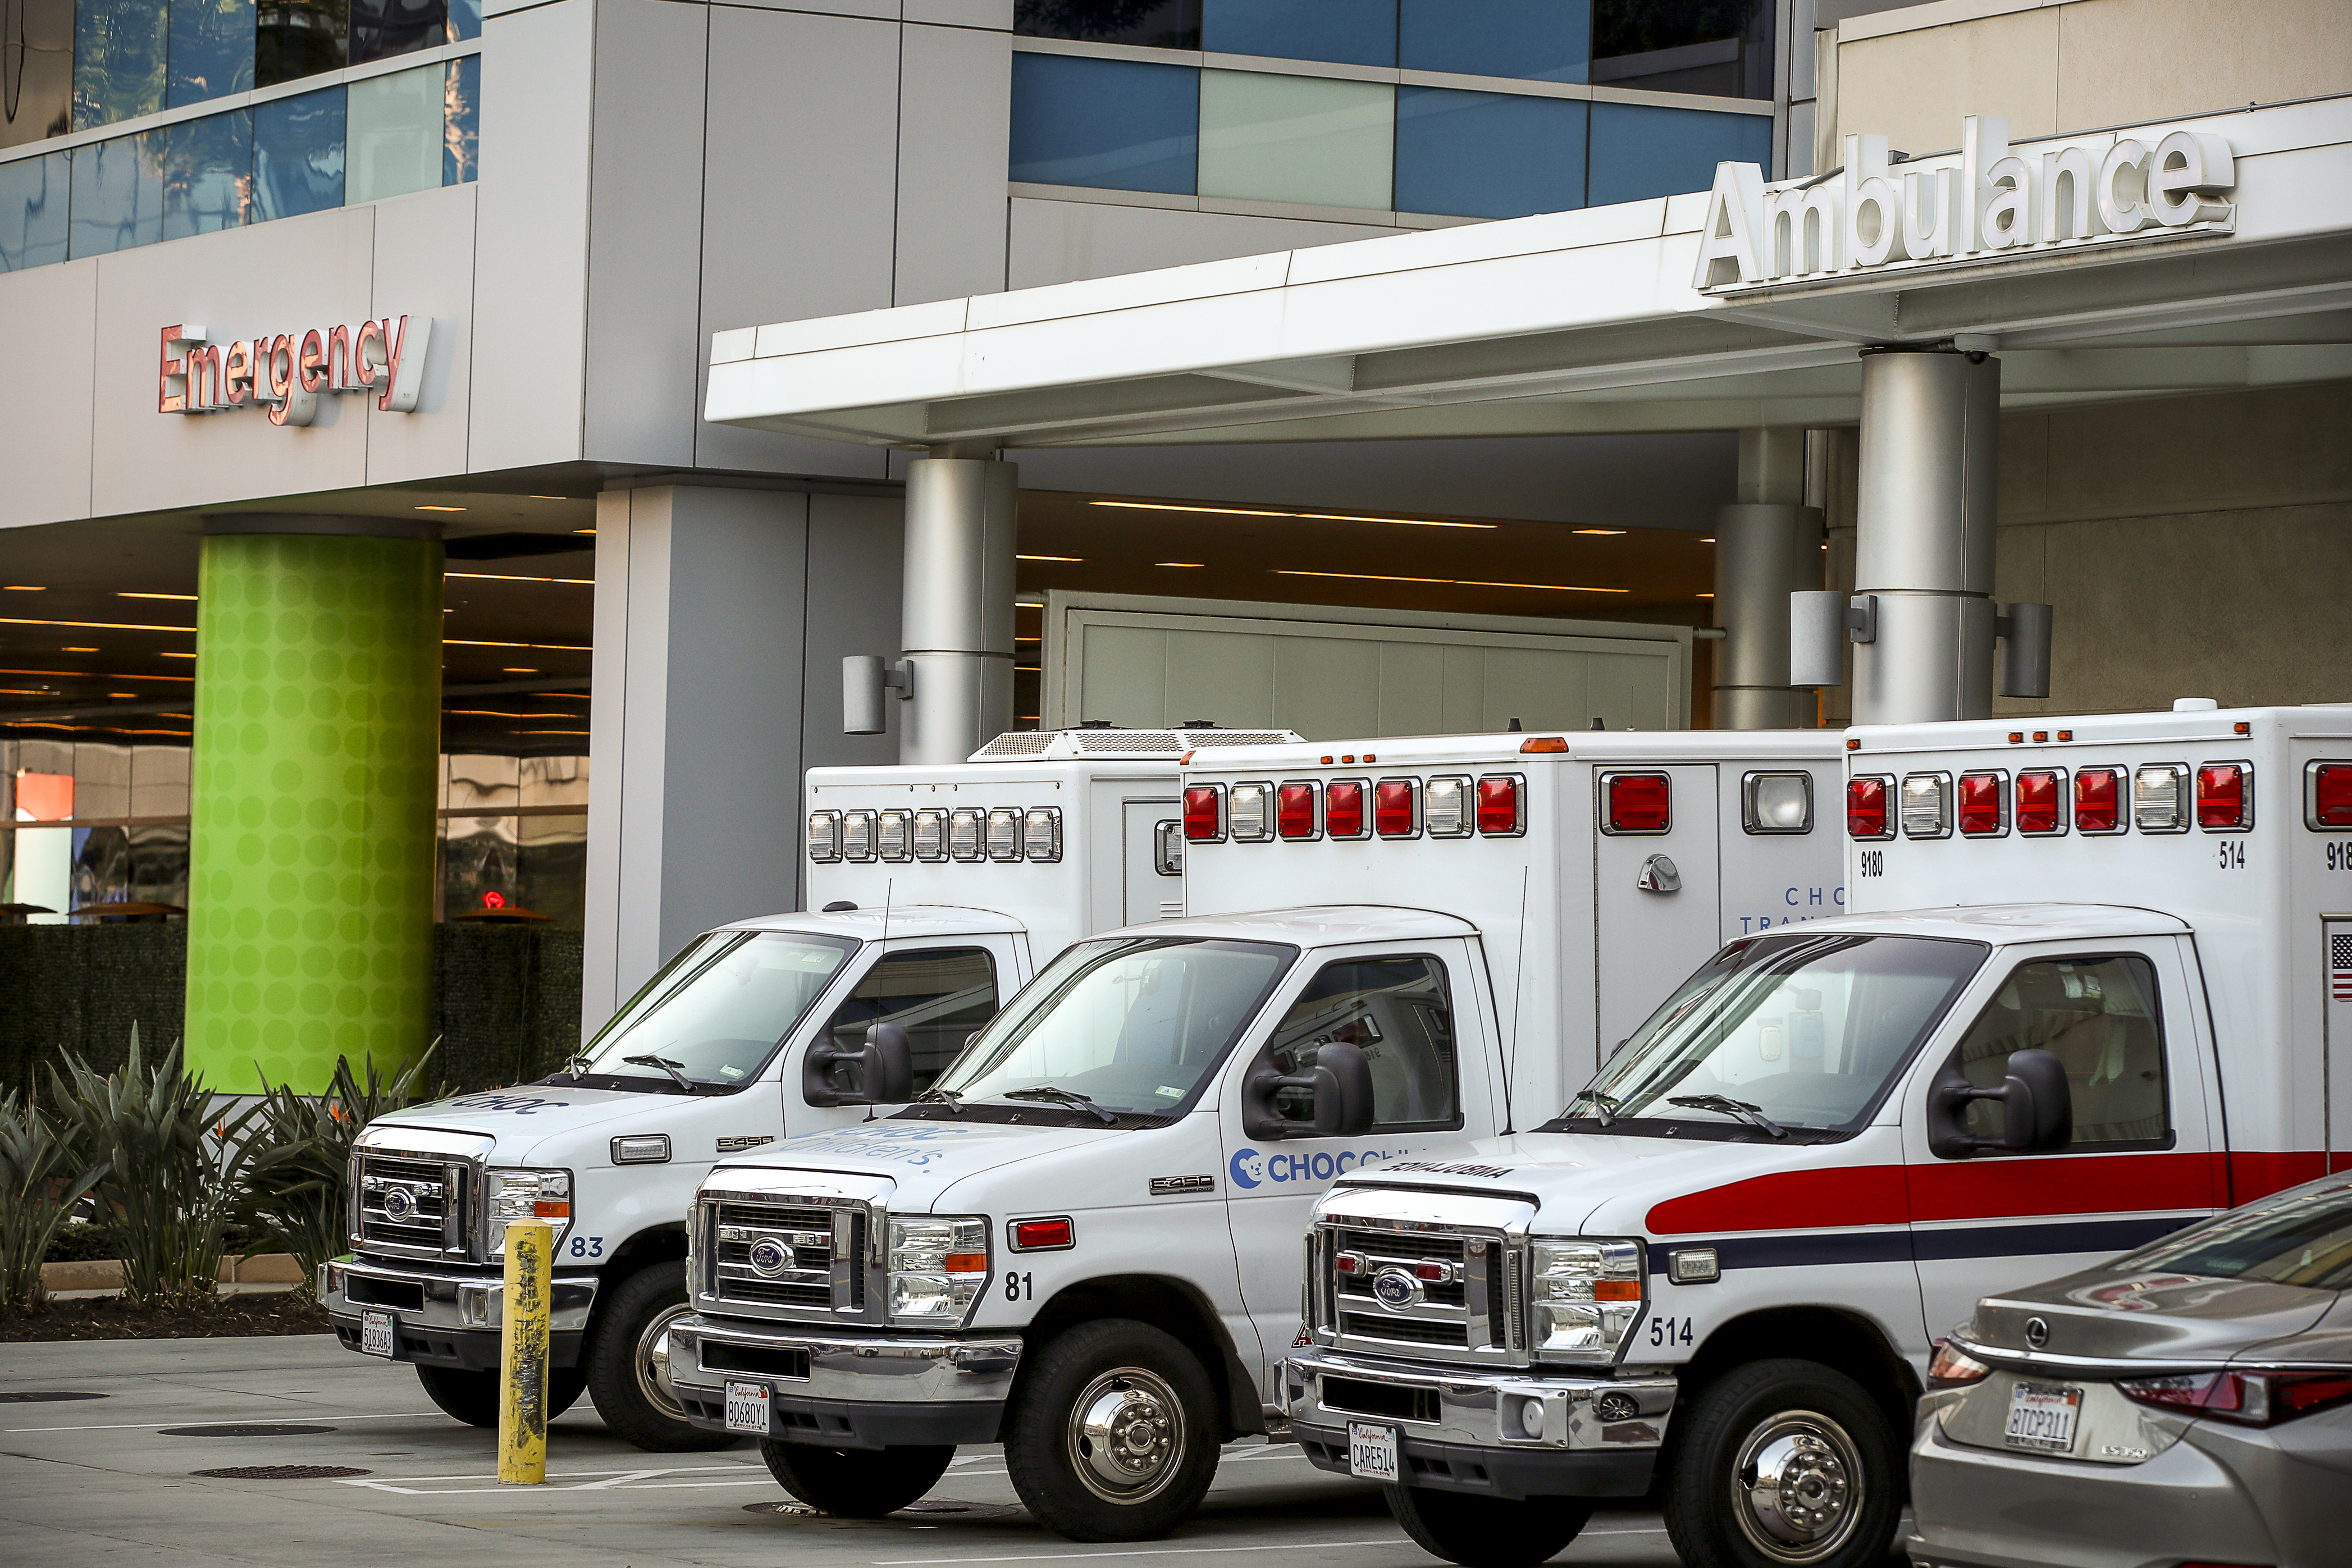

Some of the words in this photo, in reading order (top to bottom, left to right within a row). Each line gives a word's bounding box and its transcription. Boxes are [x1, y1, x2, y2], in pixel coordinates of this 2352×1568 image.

[1691, 115, 2230, 289] Ambulance
[159, 314, 411, 426] Emergency
[1861, 850, 1883, 877] 9180
[2219, 840, 2245, 869] 514
[1268, 1151, 1357, 1182] CHOC
[1151, 1175, 1213, 1188] E-450
[570, 1236, 603, 1258] 83
[756, 1247, 774, 1264] Ford
[1005, 1271, 1032, 1302] 81
[1381, 1278, 1401, 1297] Ford
[364, 1328, 391, 1350] 51836A3
[1651, 1316, 1693, 1347] 514
[734, 1386, 762, 1400] California
[728, 1400, 766, 1426] 80680Y1
[2011, 1408, 2070, 1440] 8TCP311
[1359, 1427, 1389, 1443] California
[1353, 1444, 1395, 1473] CARE514
